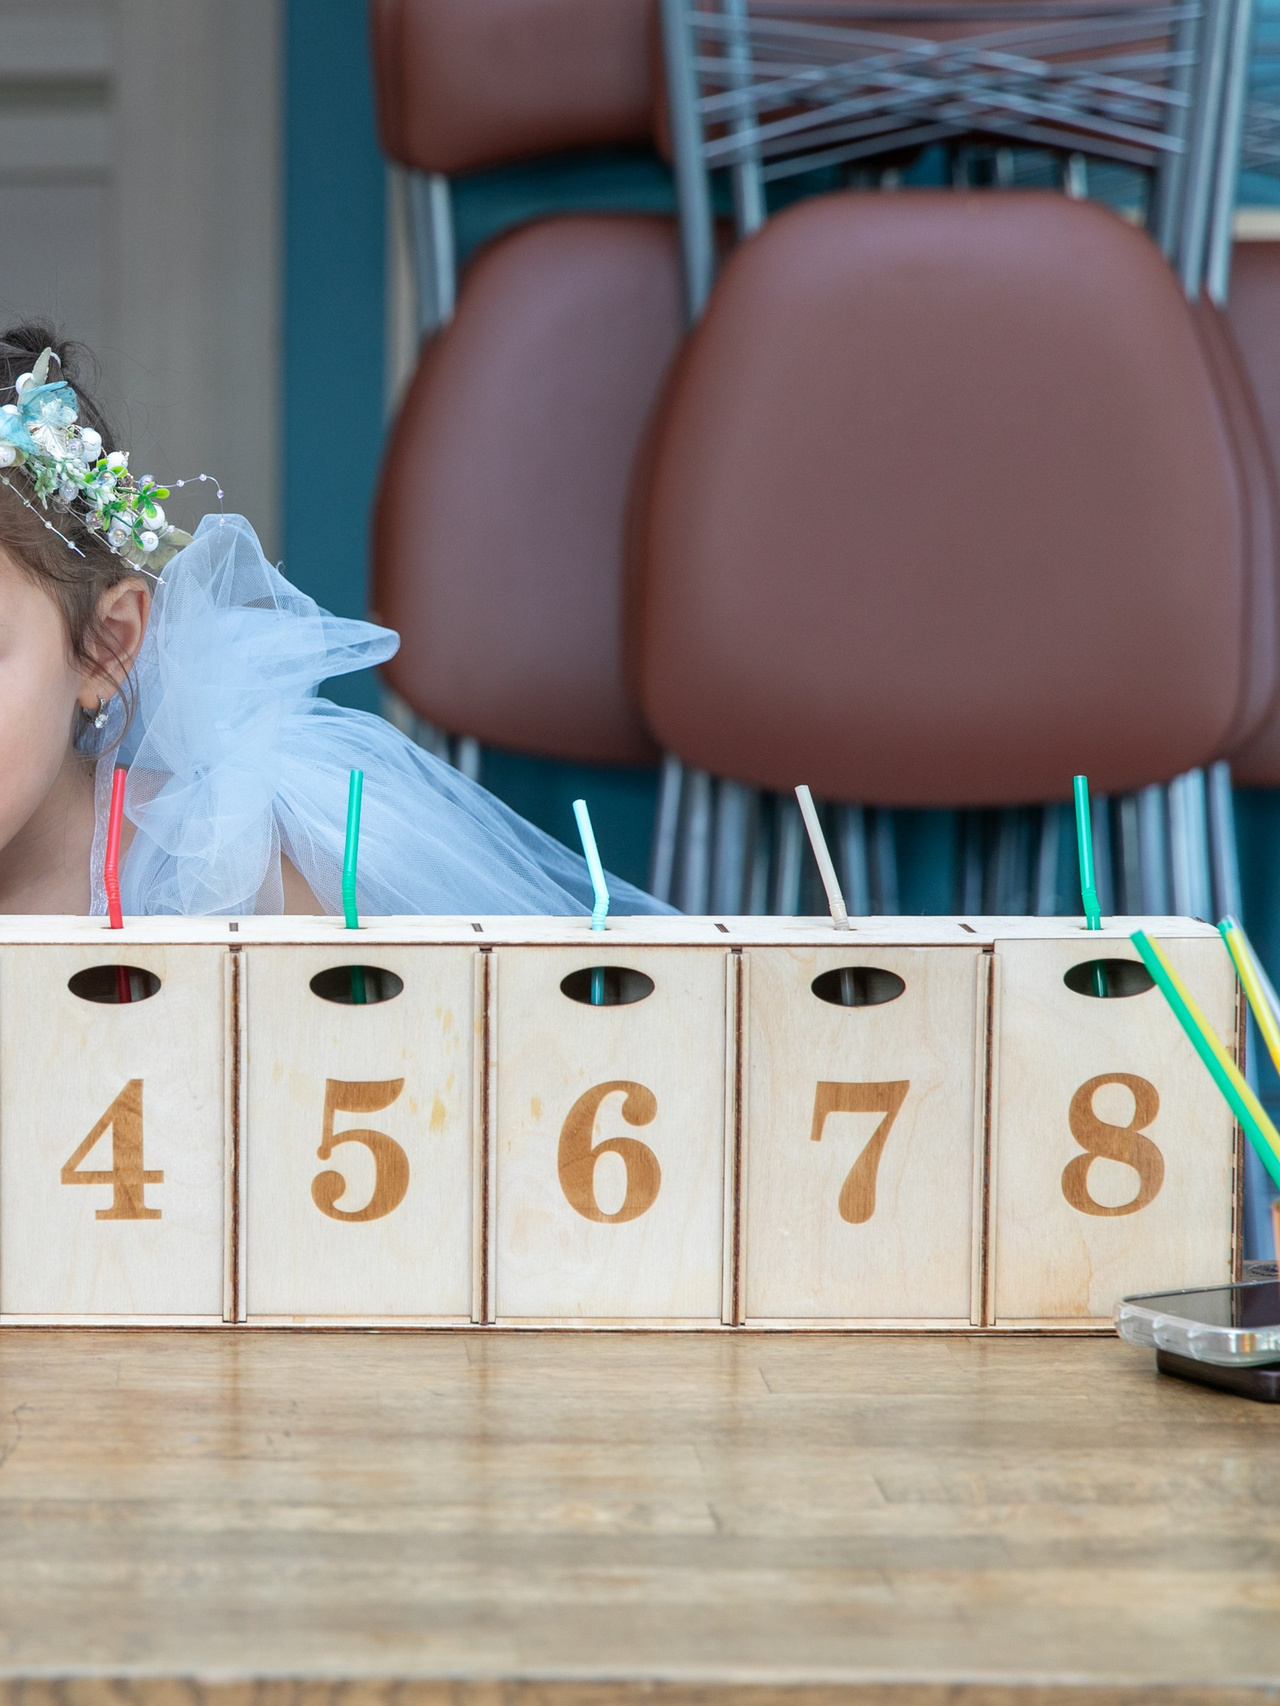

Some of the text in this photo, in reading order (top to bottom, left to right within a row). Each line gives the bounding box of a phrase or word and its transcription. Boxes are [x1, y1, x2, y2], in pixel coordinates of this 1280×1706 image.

[61, 1078, 164, 1221] 4
[311, 1077, 410, 1222] 5
[557, 1080, 661, 1224] 6
[810, 1079, 909, 1224] 7
[1061, 1072, 1165, 1217] 8
